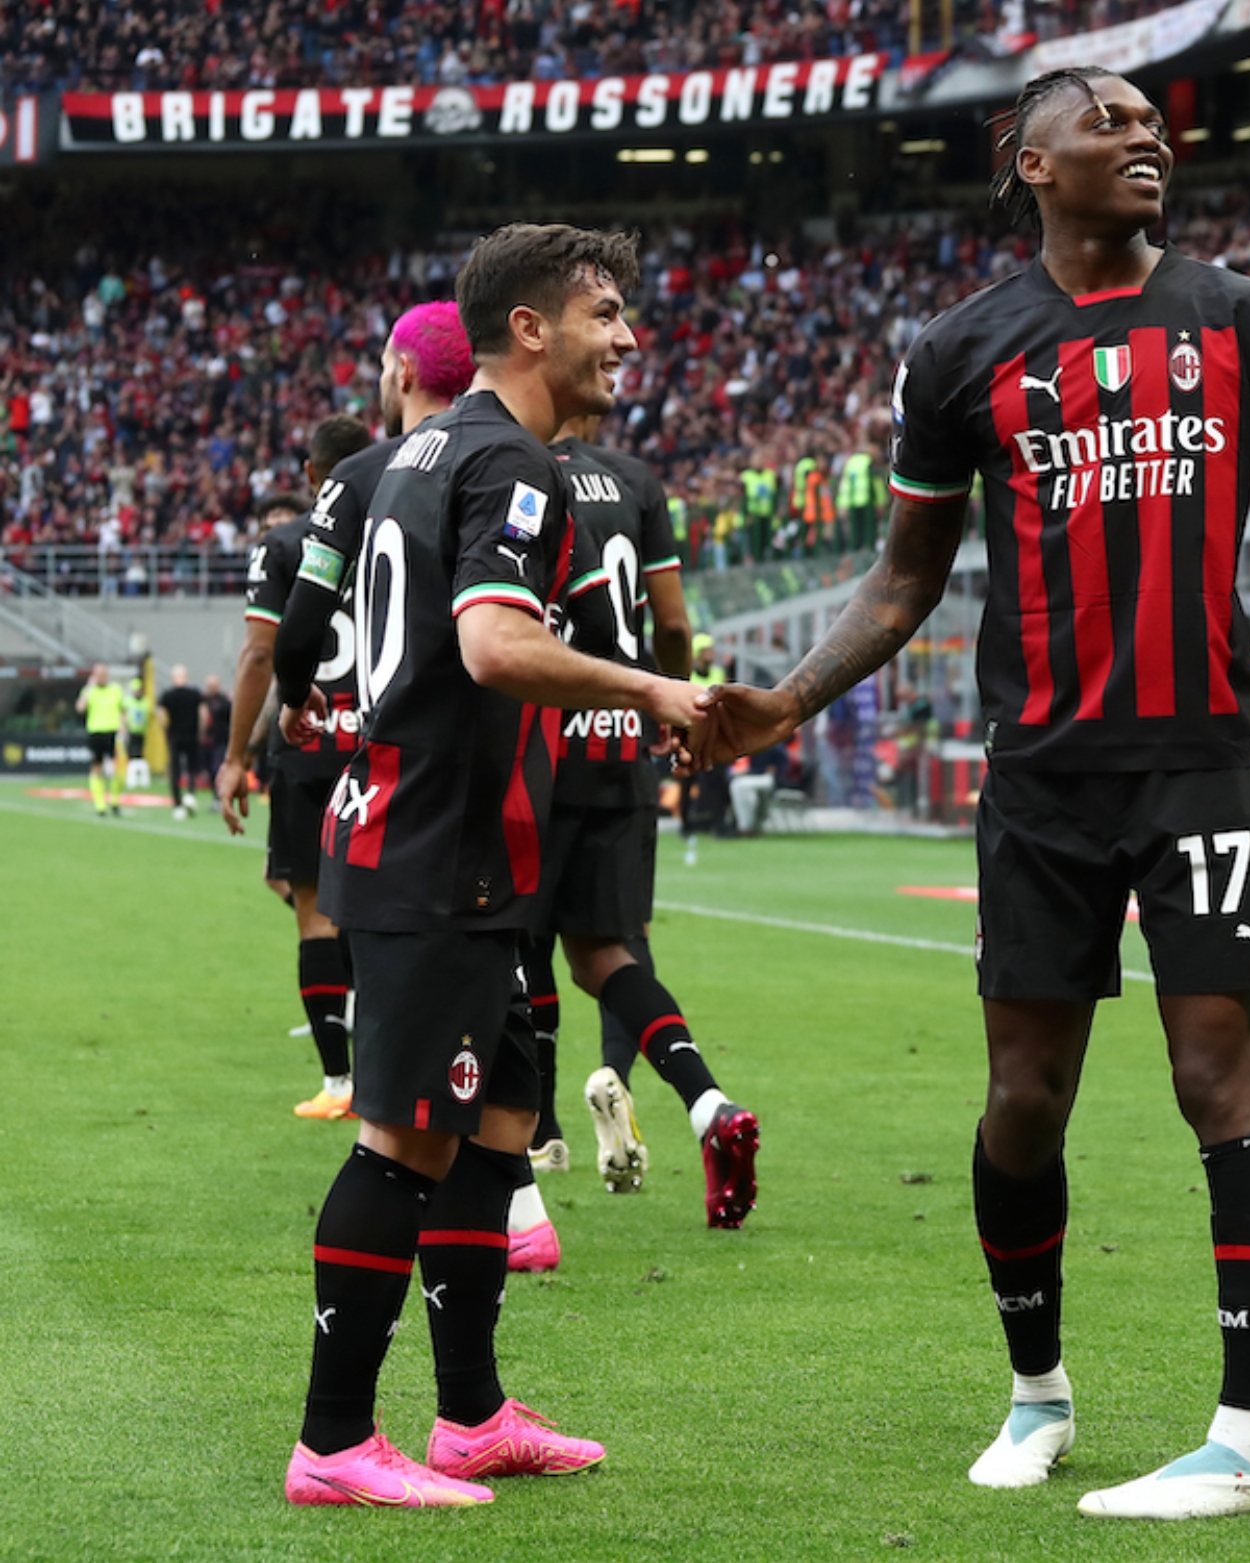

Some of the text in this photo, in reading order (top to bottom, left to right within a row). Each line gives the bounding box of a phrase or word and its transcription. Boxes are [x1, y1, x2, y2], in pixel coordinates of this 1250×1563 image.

[111, 87, 414, 142] BRIGATE
[499, 54, 878, 132] ROSSONERE
[1013, 409, 1225, 472] Emirates
[1051, 459, 1194, 510] FLY BETTER
